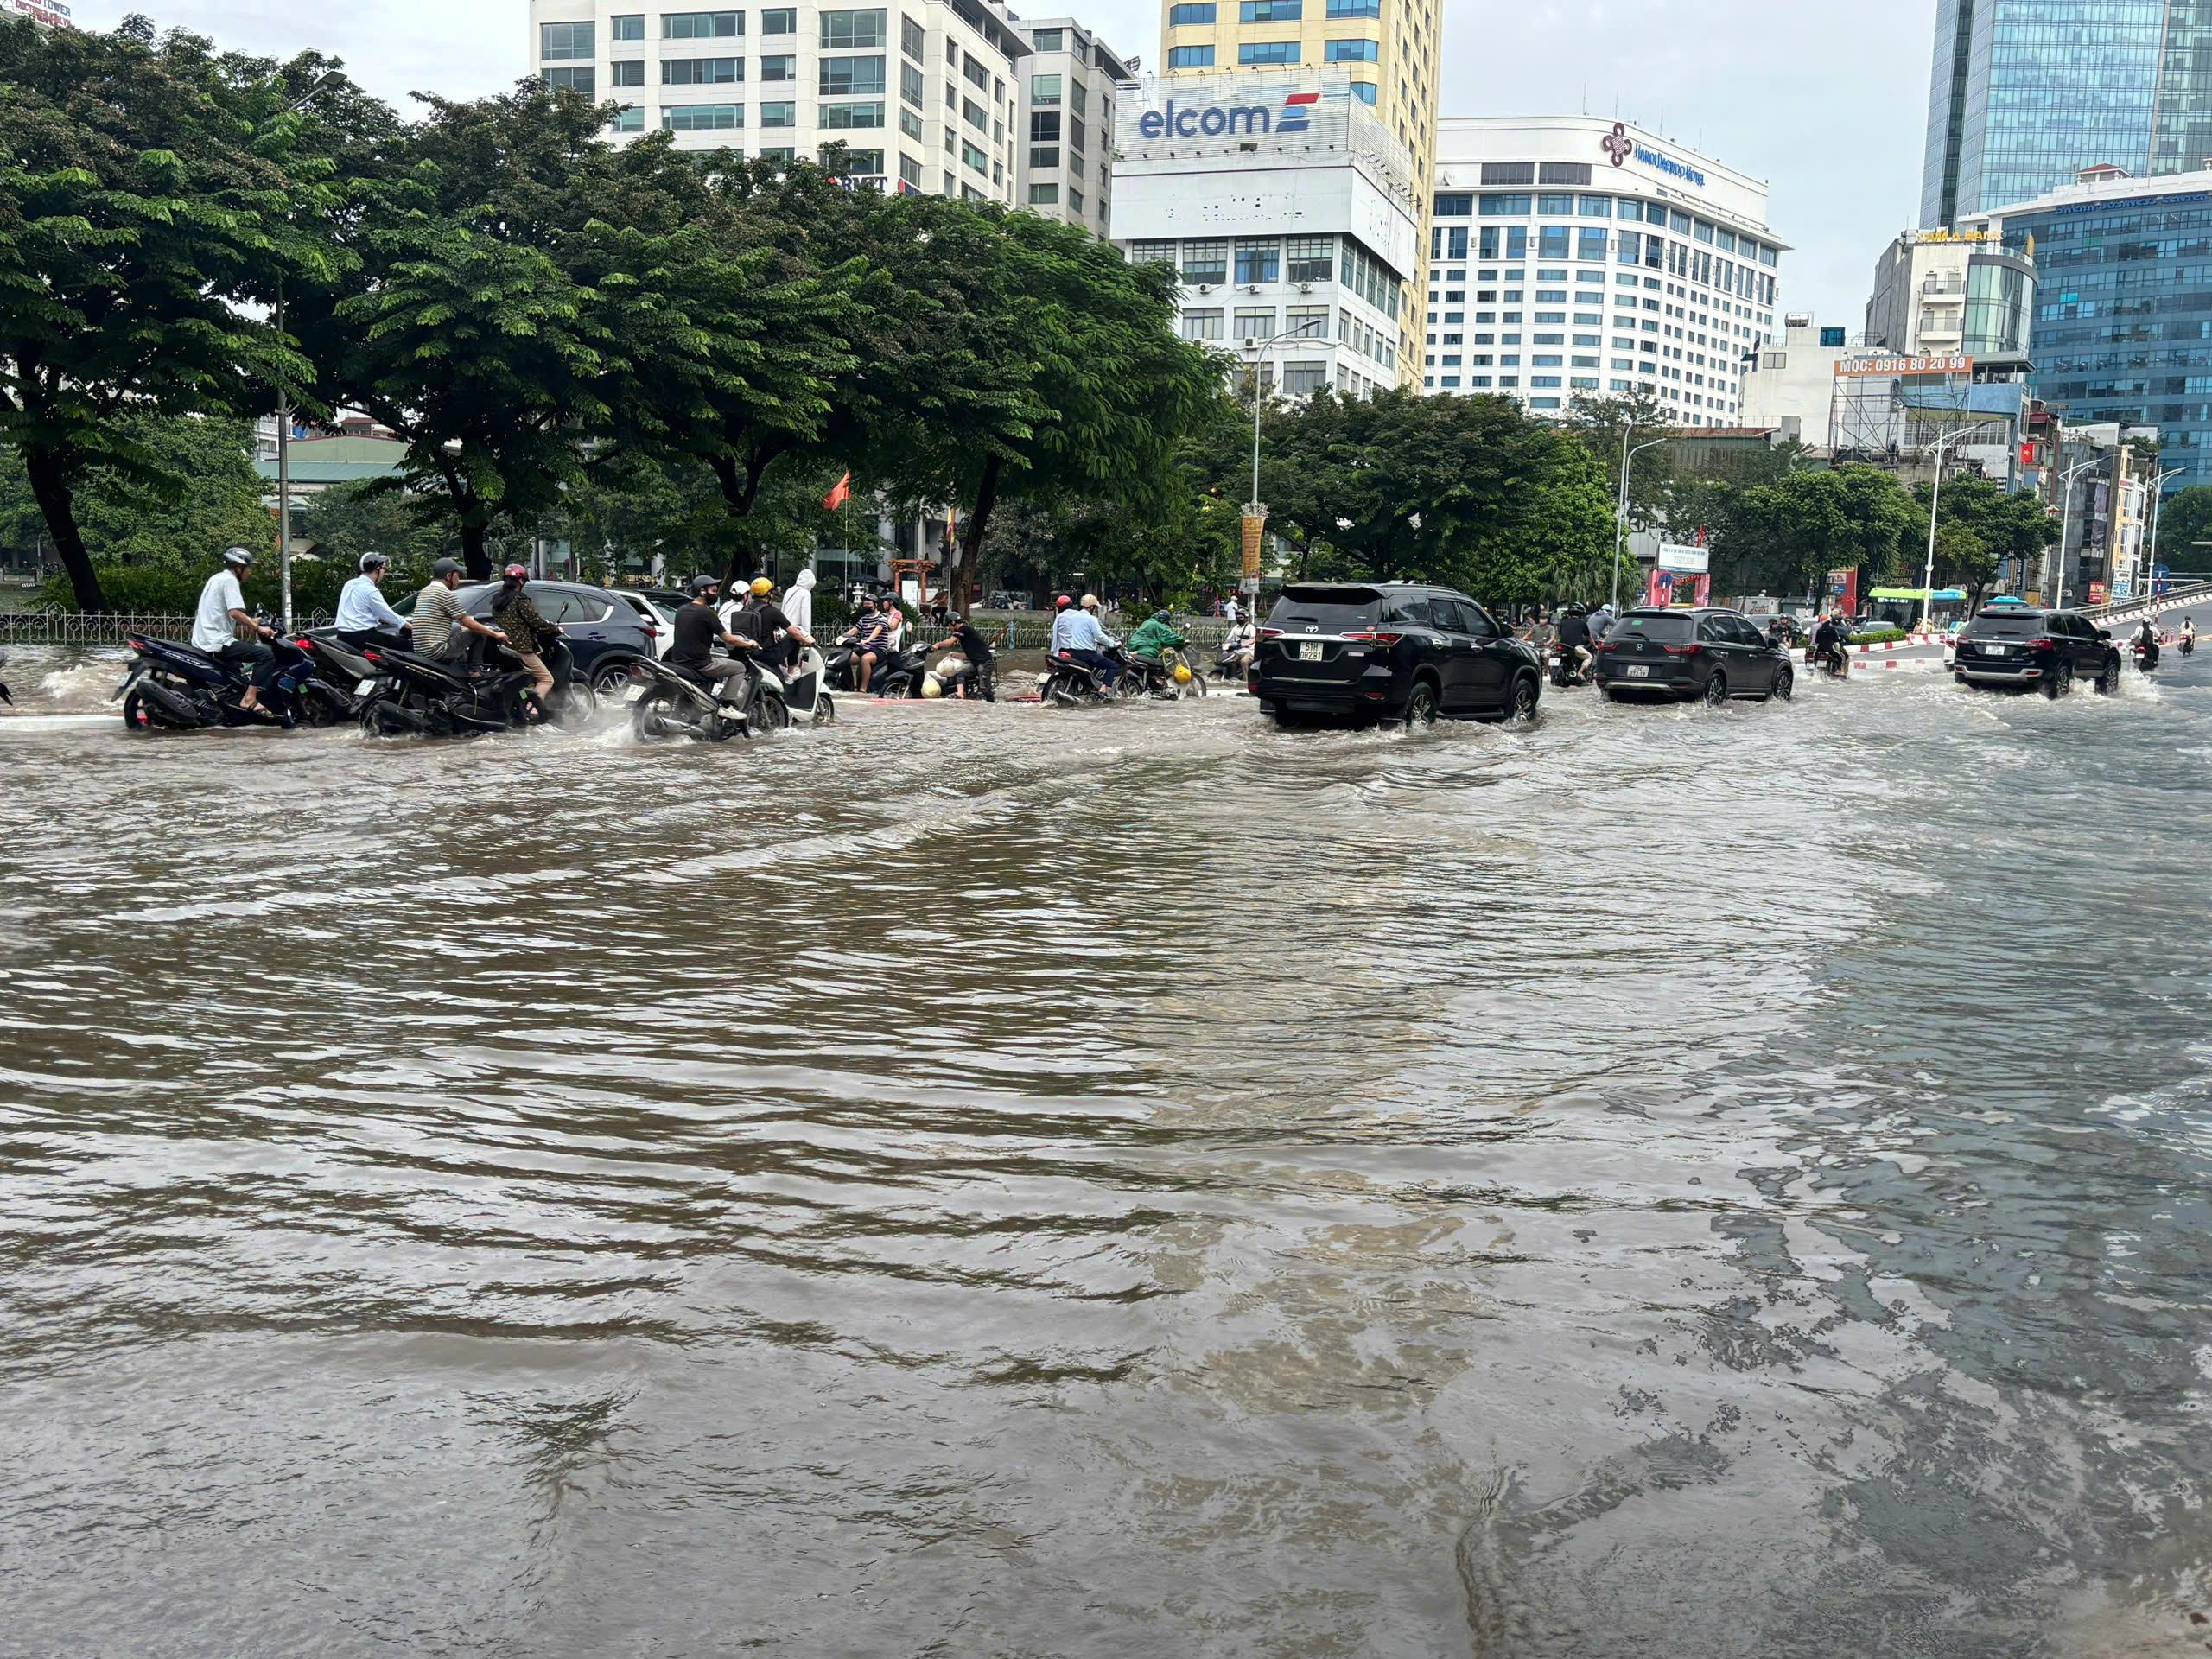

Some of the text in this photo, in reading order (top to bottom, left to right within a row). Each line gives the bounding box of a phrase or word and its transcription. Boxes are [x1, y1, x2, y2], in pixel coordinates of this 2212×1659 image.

[44, 0, 70, 16] TOWER
[1140, 99, 1270, 138] elcom
[1635, 143, 1706, 187] HANOI DAEWOO HOTEL
[1964, 229, 2005, 242] BANK
[1839, 357, 1966, 372] MQC: 0916 80 20 99
[1305, 642, 1319, 652] 51H
